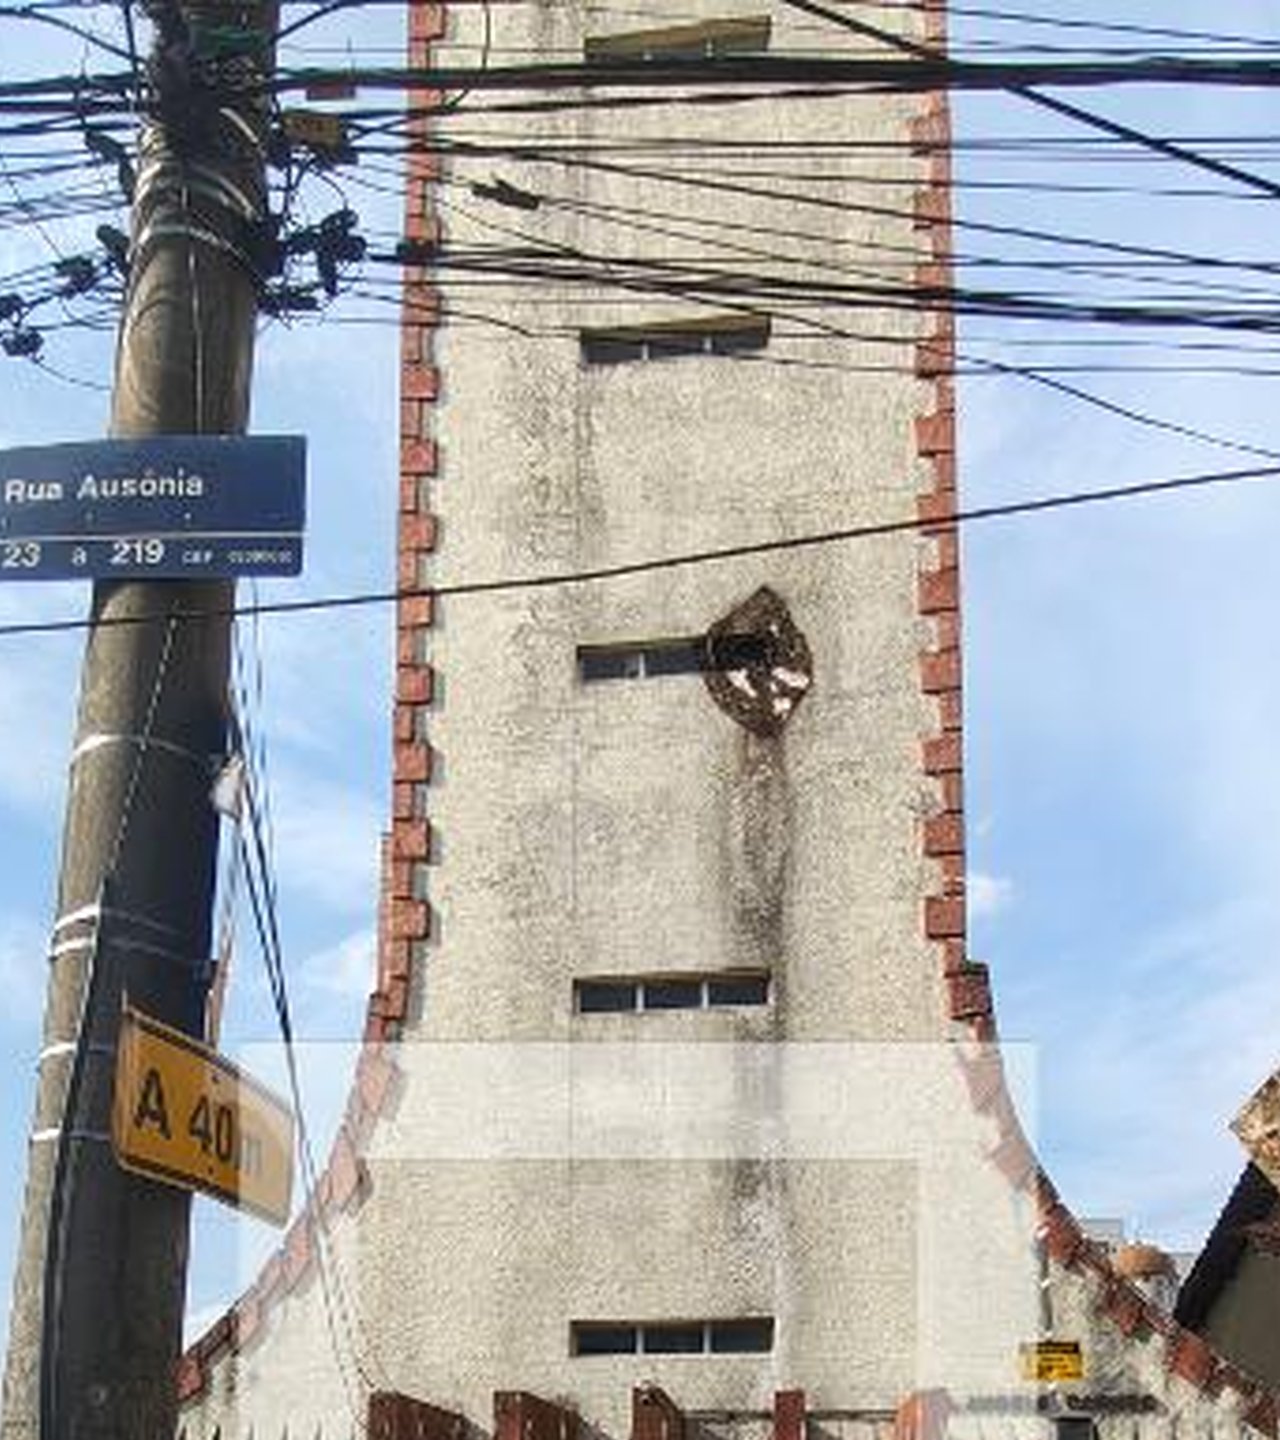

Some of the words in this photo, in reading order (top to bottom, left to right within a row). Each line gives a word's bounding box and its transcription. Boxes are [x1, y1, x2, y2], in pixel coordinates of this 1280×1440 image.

[5, 478, 64, 504] Rua
[2, 542, 41, 569] 23
[72, 548, 87, 566] a
[110, 538, 166, 567] 219
[134, 1067, 171, 1141] A
